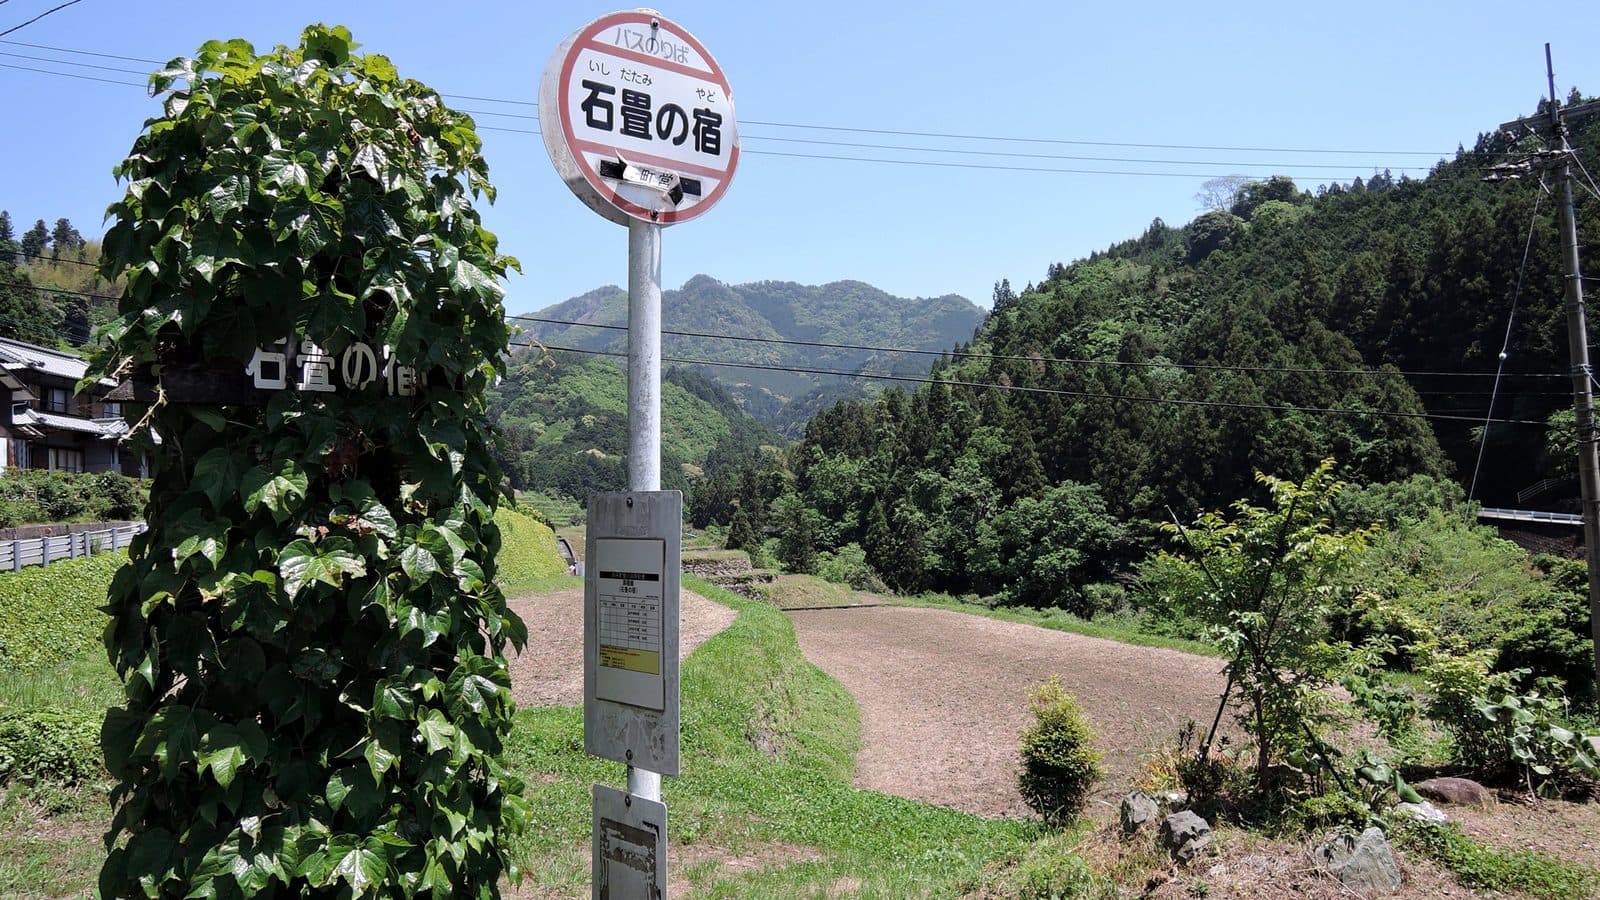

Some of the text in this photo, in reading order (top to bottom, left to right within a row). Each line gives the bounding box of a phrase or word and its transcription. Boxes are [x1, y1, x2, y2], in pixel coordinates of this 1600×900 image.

[615, 27, 689, 64] バスのりば
[589, 60, 716, 103] いし だたみ やど
[581, 79, 722, 155] 石畳の宿
